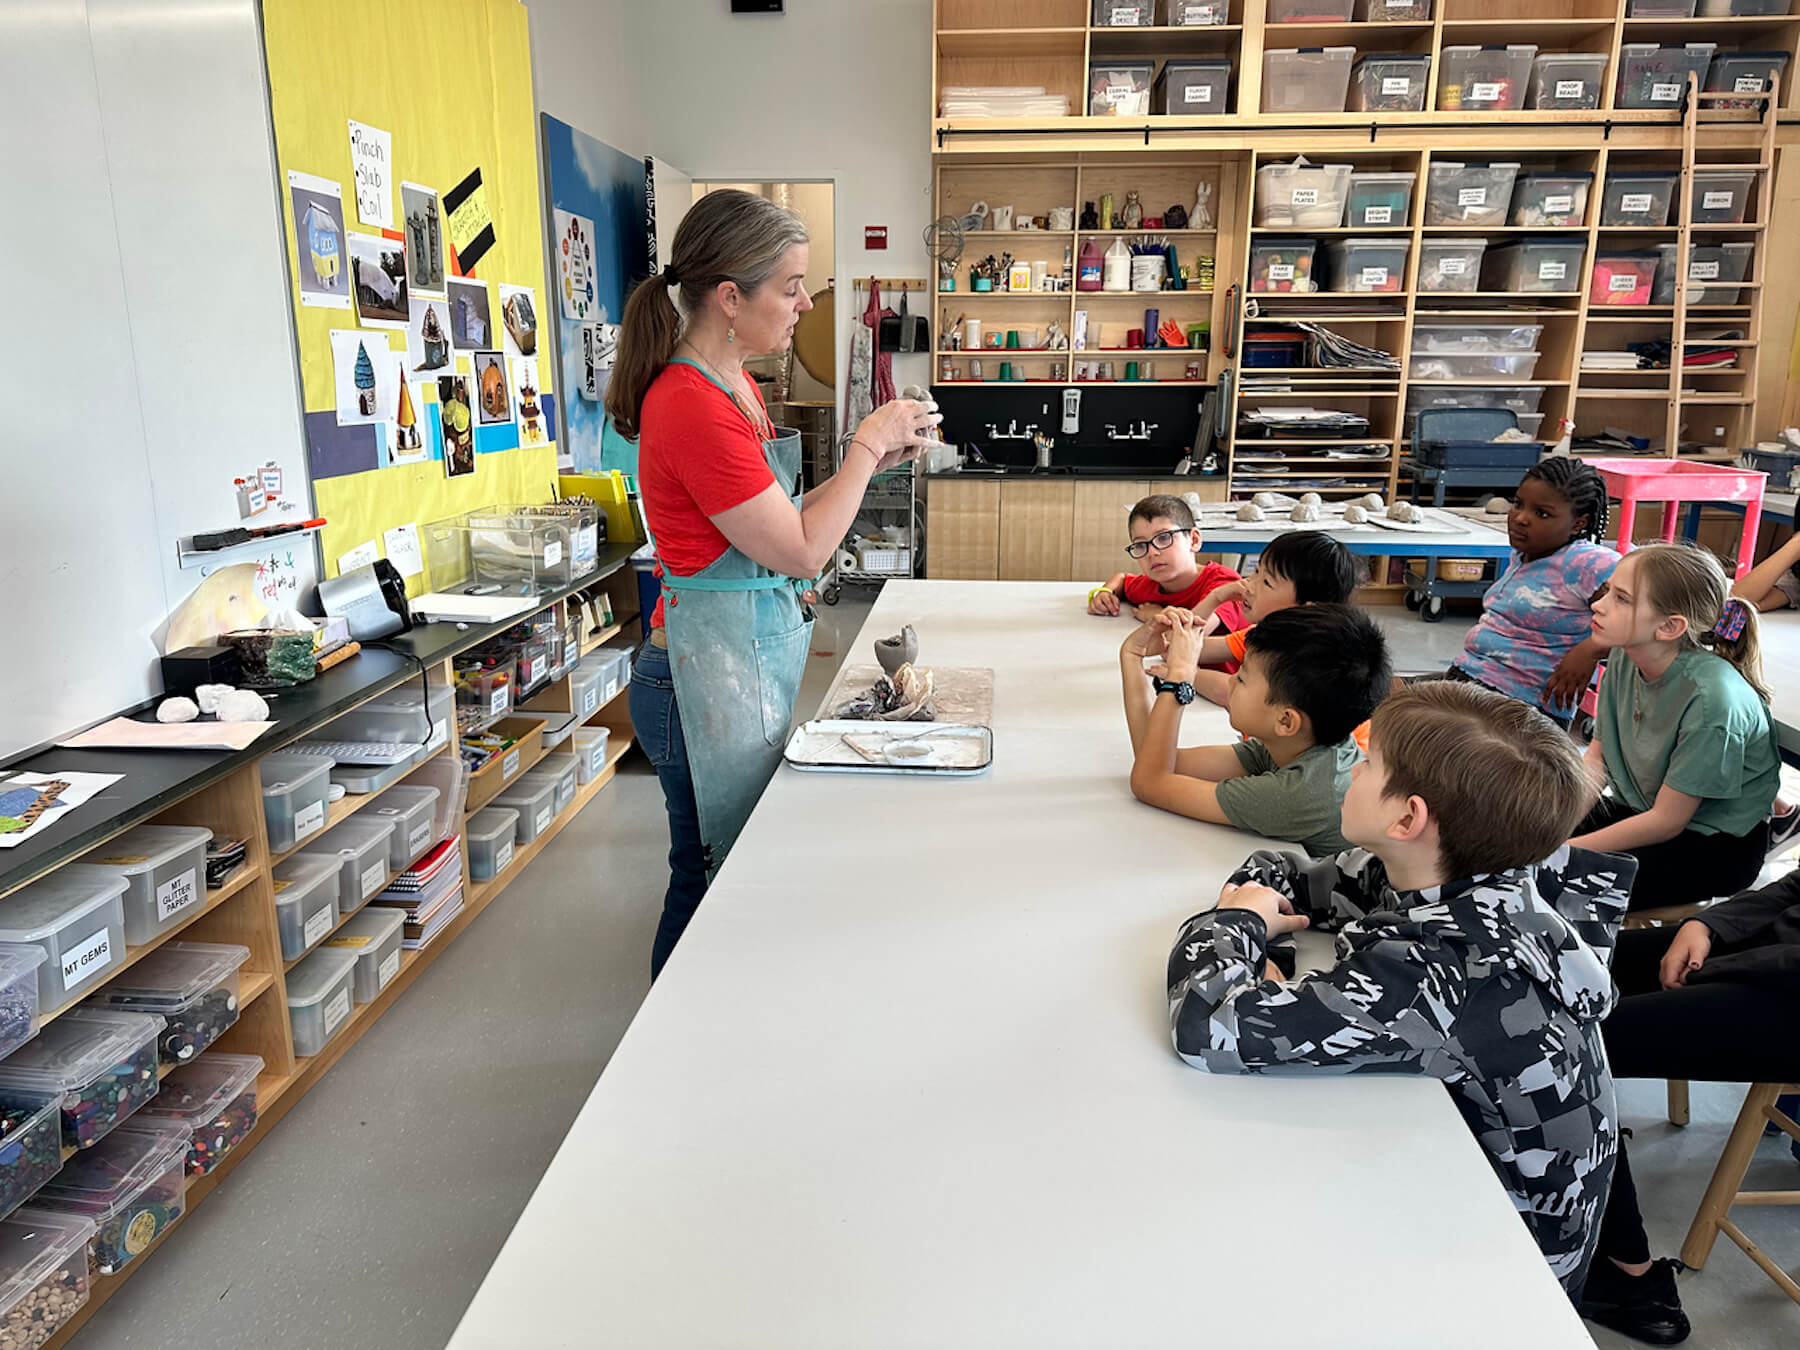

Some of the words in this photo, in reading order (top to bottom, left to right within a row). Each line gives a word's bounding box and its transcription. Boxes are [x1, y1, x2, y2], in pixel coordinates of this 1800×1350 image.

[354, 129, 384, 162] Pinch
[358, 162, 382, 188] Slab
[360, 190, 383, 220] Coil
[162, 883, 191, 905] GLITTER
[171, 879, 181, 890] MT
[167, 894, 189, 912] PAPER
[64, 960, 79, 977] MT
[80, 941, 108, 966] GEMS
